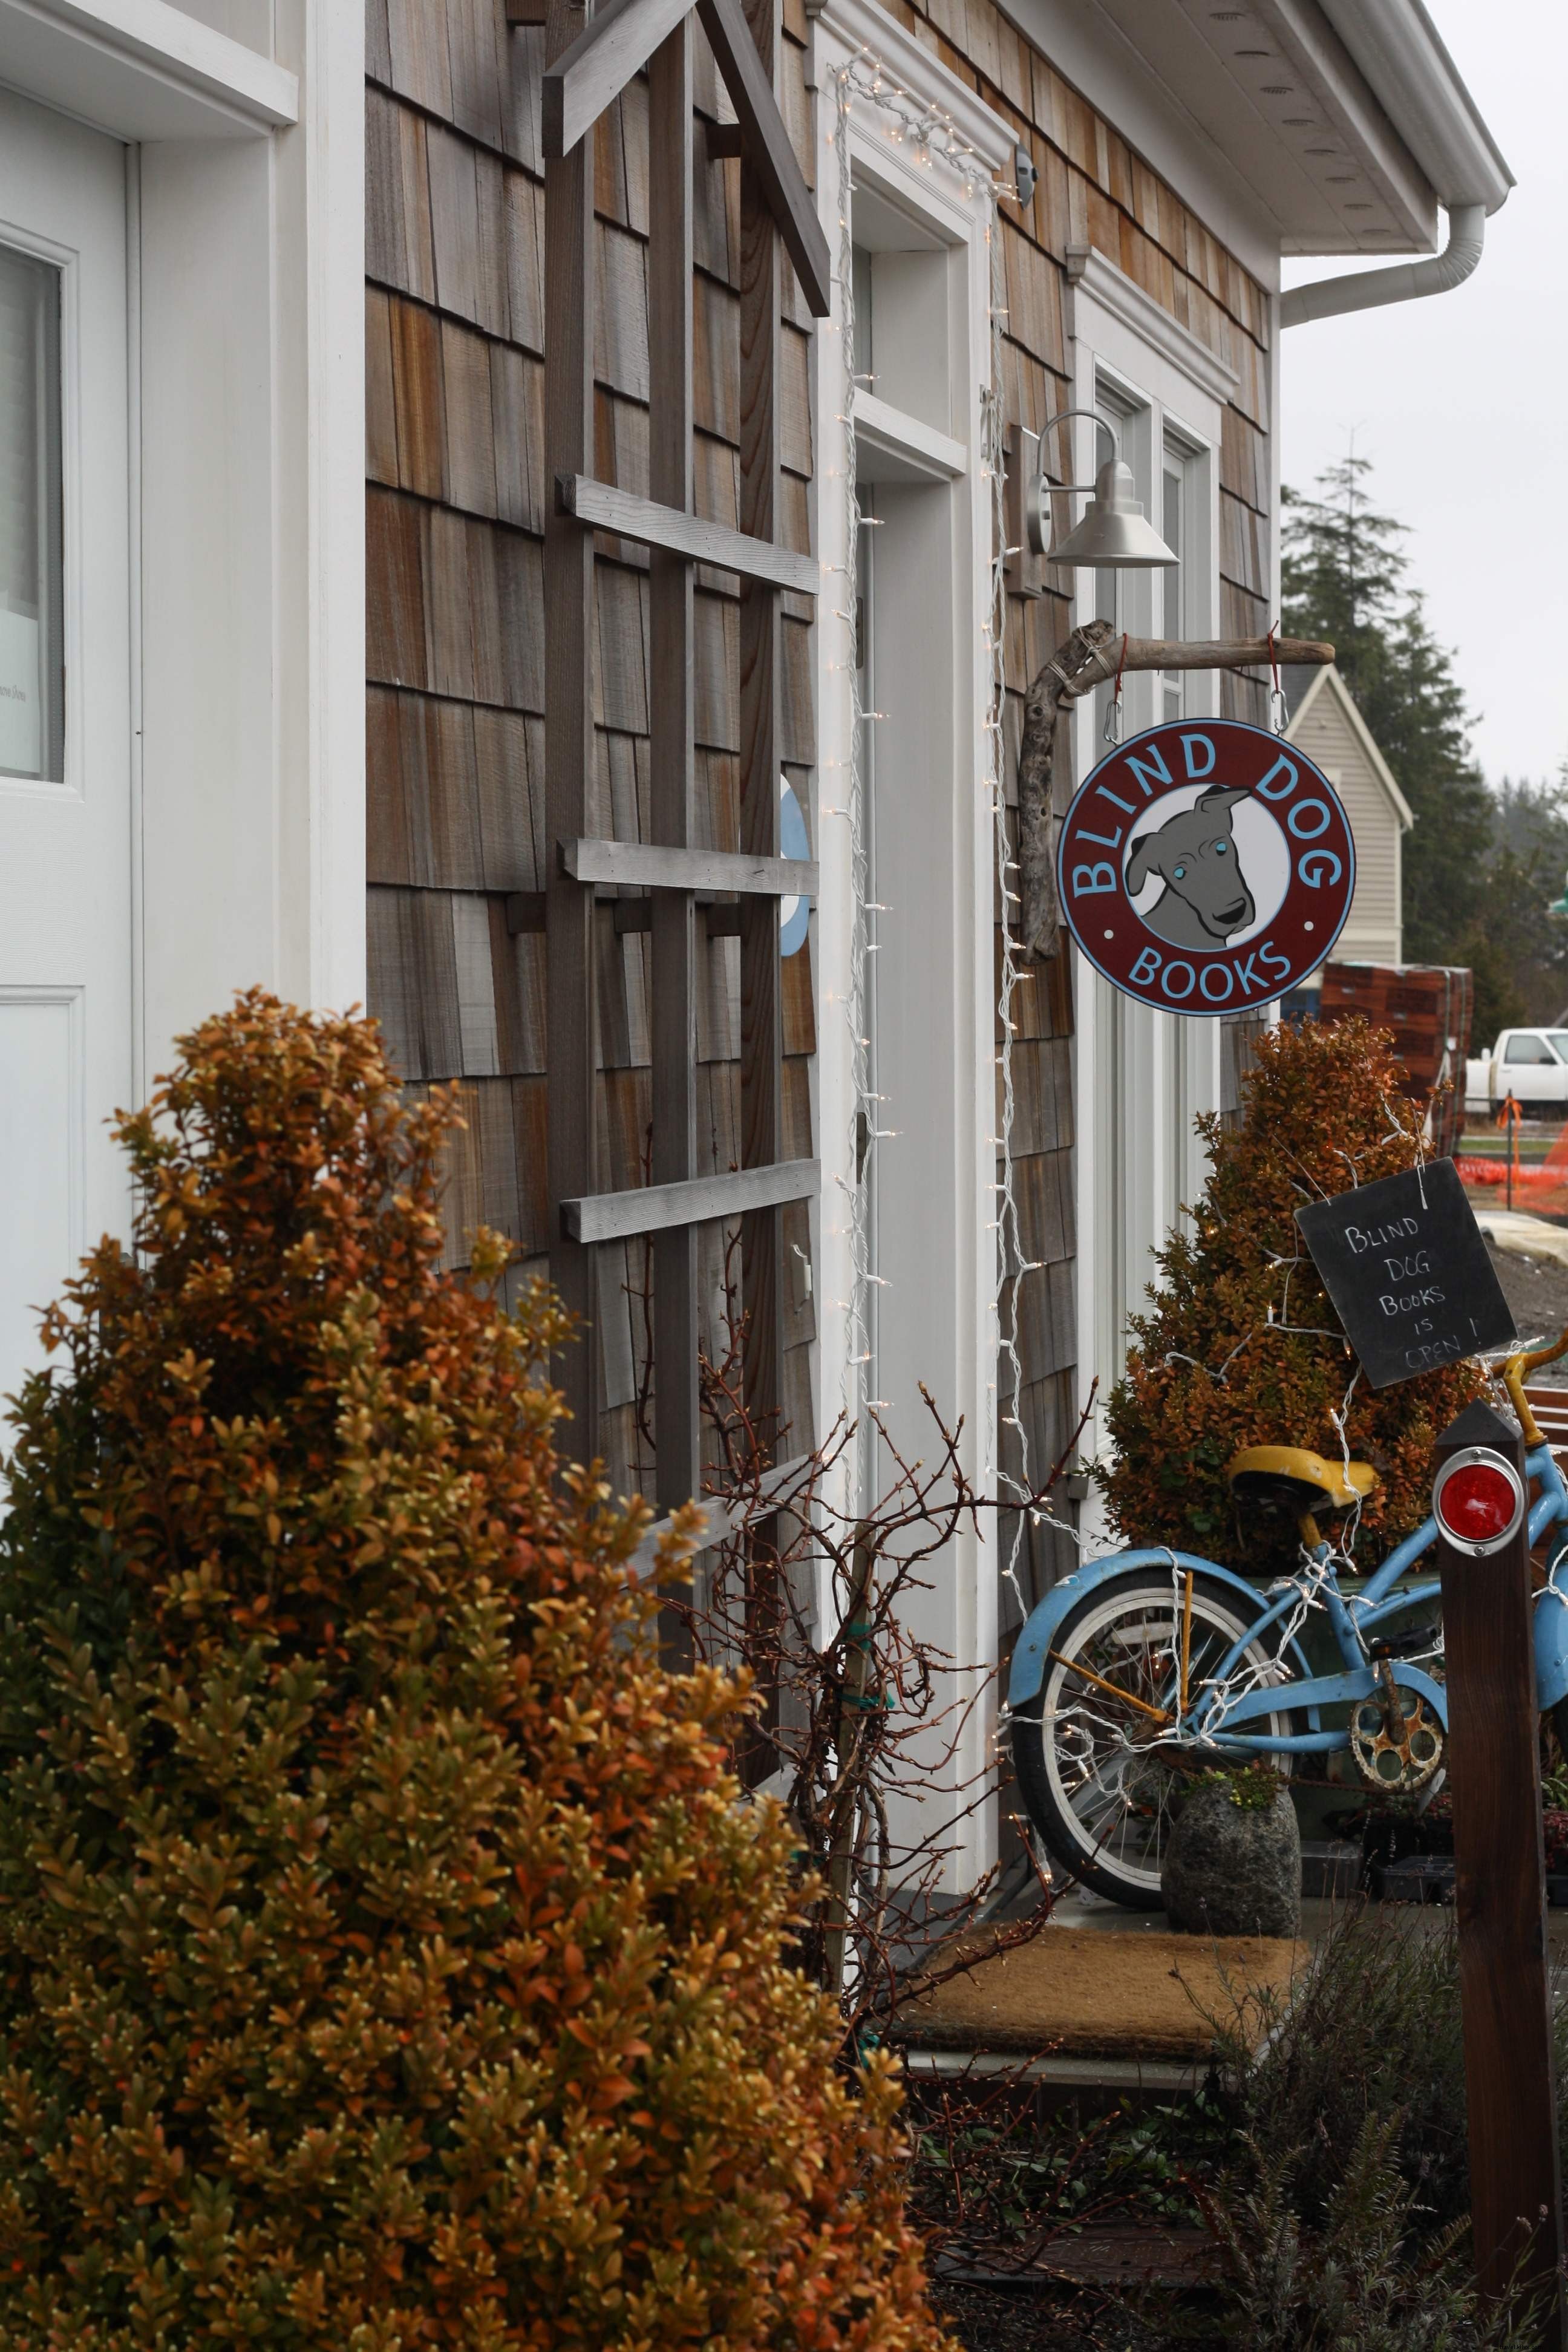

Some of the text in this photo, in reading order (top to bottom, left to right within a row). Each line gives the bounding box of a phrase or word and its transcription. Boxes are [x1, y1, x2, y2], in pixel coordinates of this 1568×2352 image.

[1072, 733, 1342, 898] BLIND DOG
[1128, 941, 1291, 1002] BOOKS
[1345, 1218, 1419, 1253] BLIND
[1384, 1250, 1430, 1281] DOG
[1379, 1286, 1446, 1316] BOOKS
